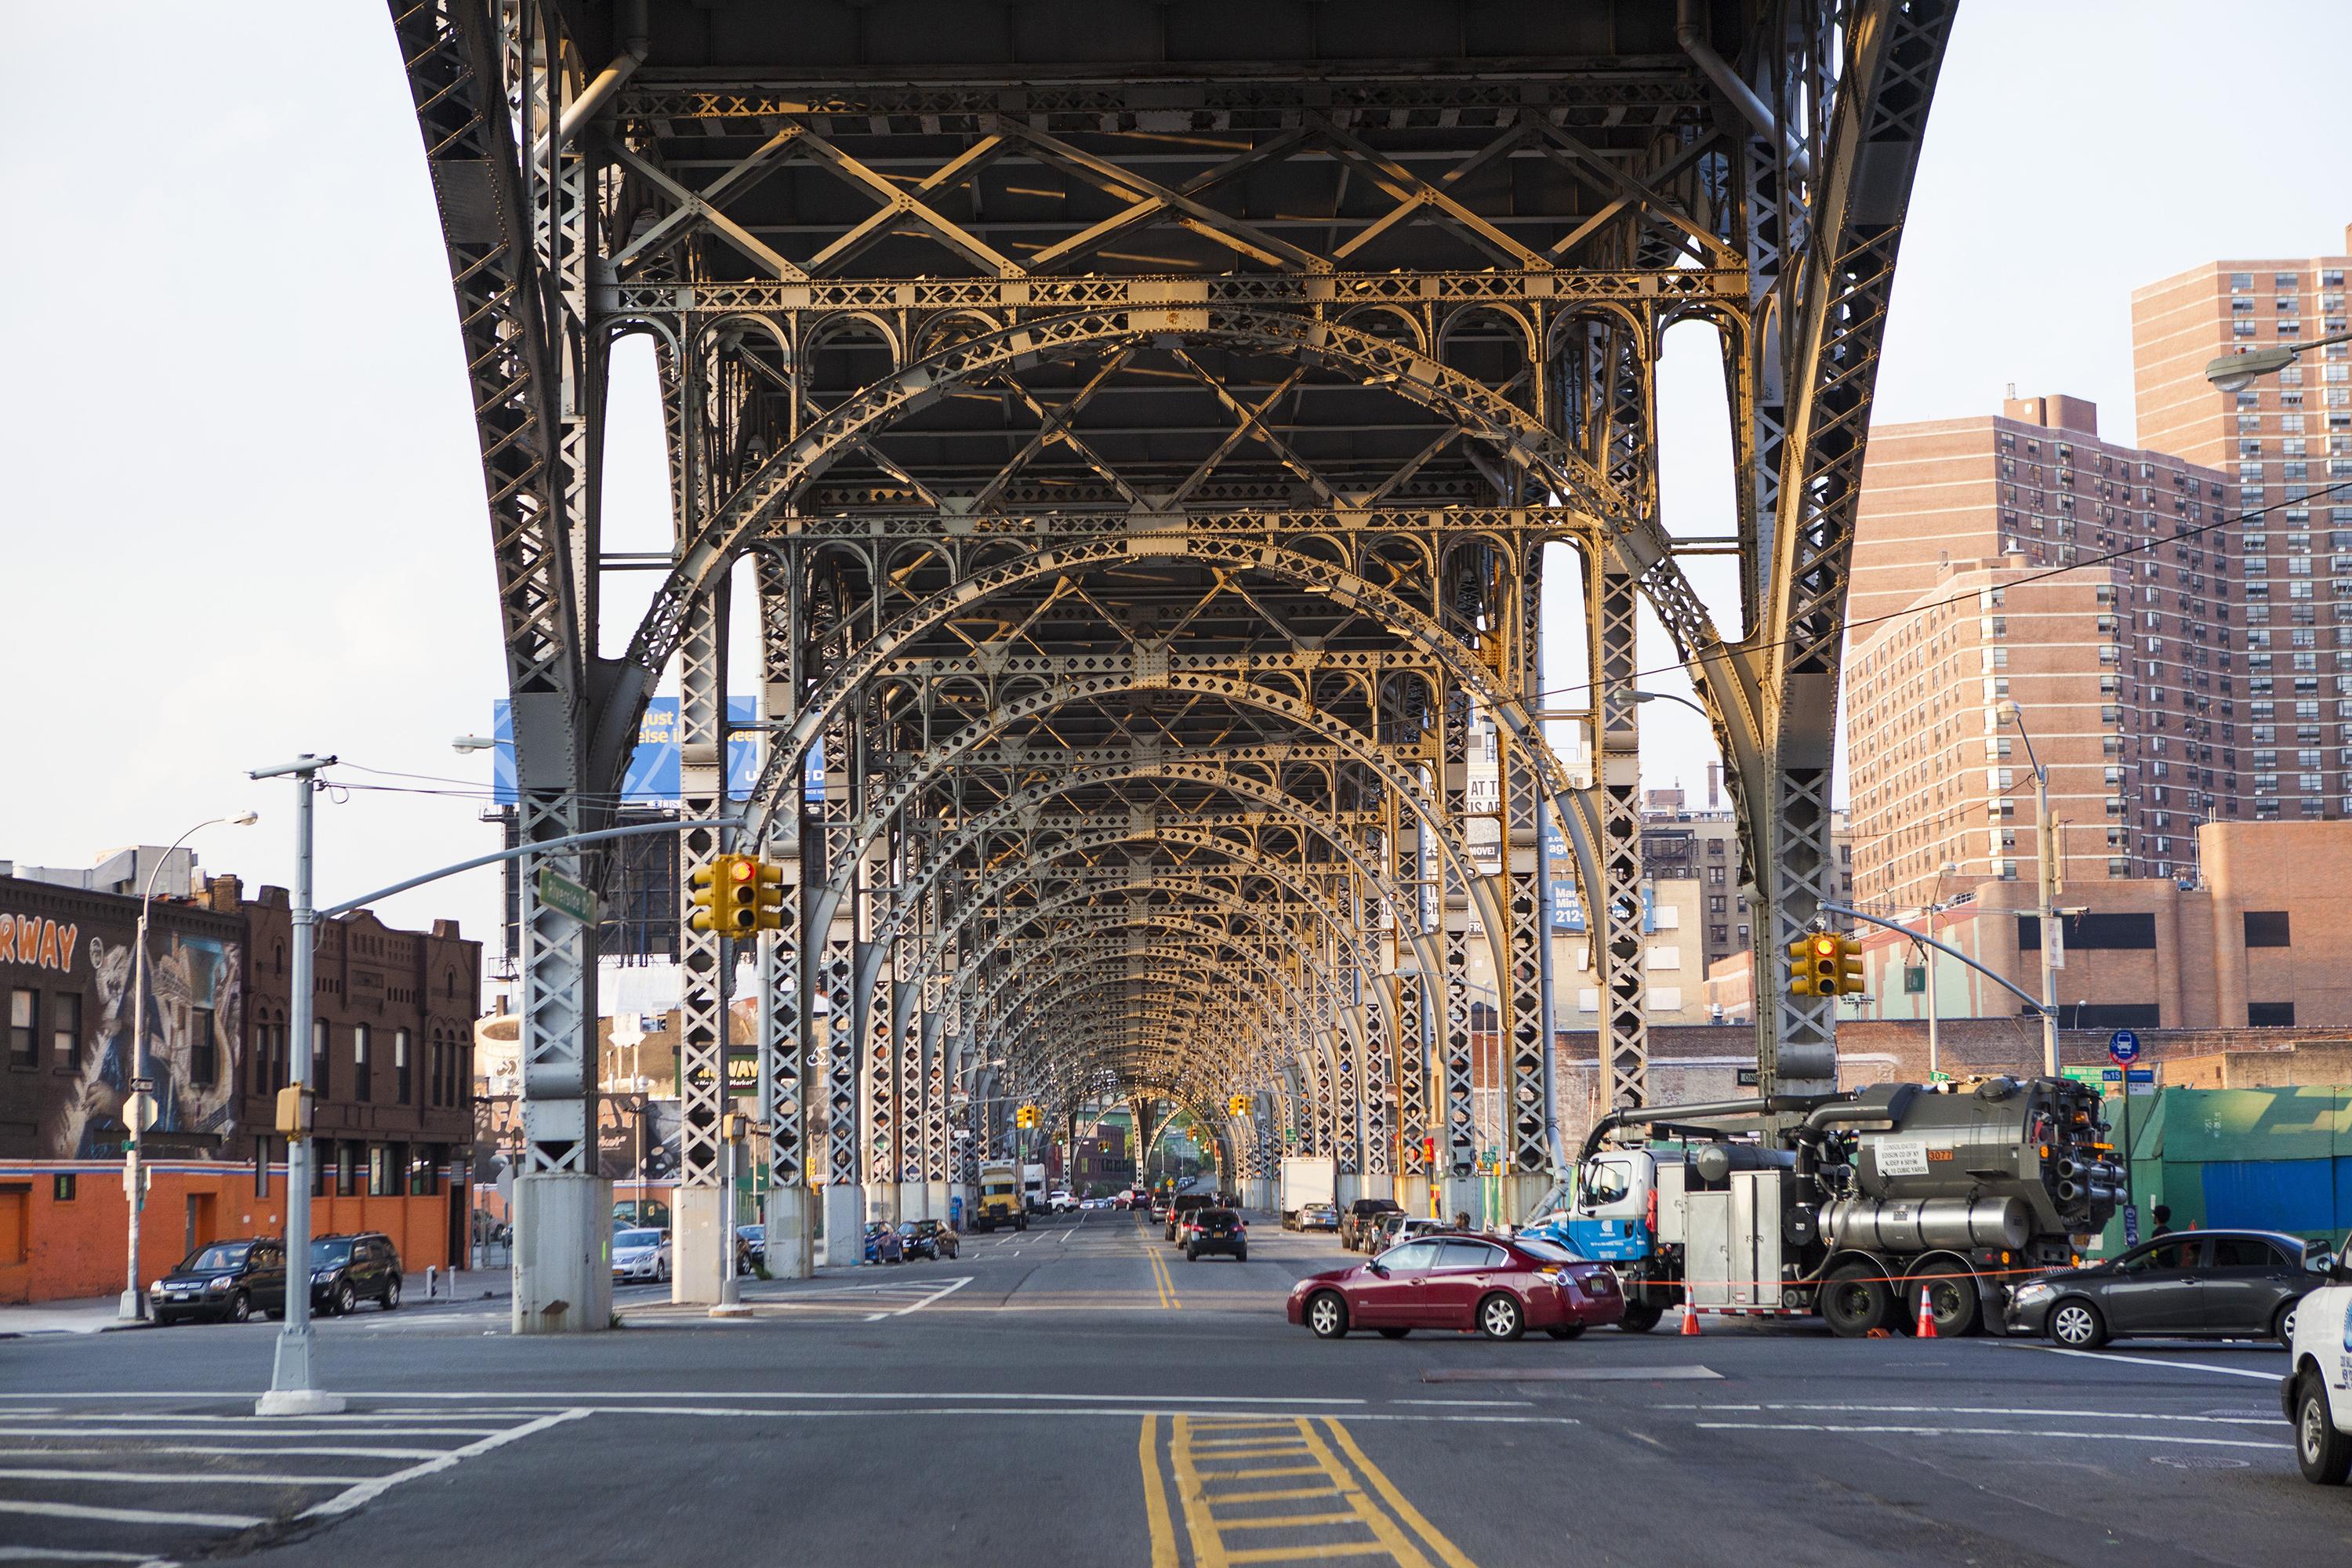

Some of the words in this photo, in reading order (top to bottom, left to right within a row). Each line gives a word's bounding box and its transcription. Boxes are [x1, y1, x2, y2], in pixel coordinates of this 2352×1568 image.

[1472, 780, 1485, 796] AT
[1468, 847, 1495, 855] MOVE!
[0, 913, 78, 973] RWAY
[2103, 1071, 2120, 1080] Bx15
[1929, 1151, 1951, 1160] 3077
